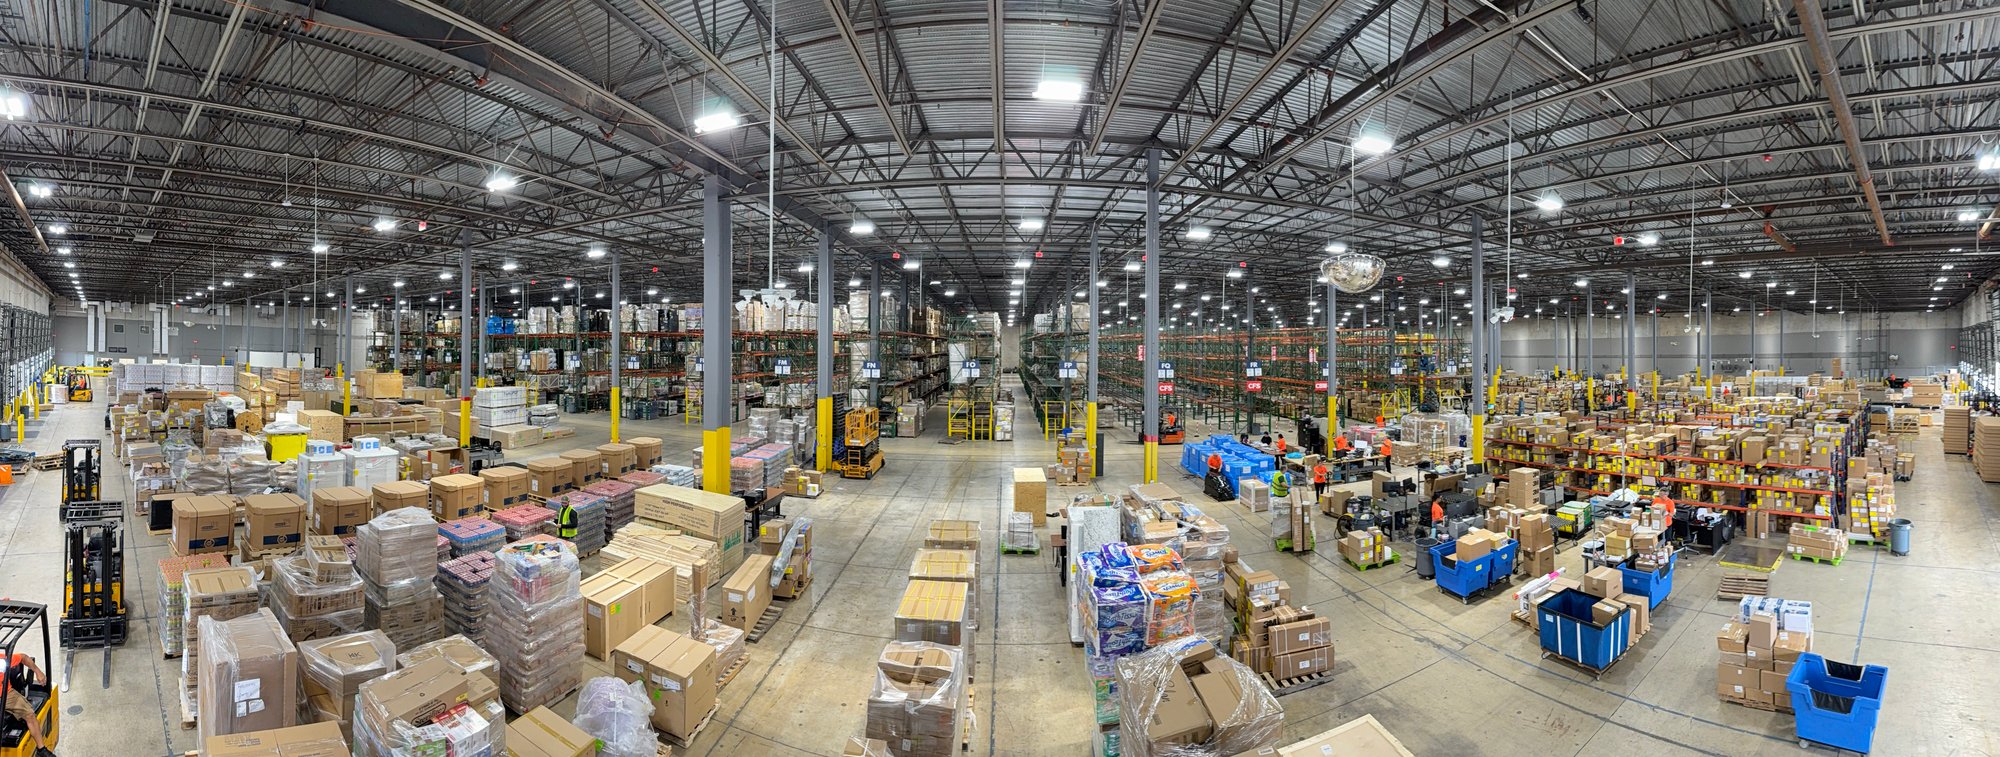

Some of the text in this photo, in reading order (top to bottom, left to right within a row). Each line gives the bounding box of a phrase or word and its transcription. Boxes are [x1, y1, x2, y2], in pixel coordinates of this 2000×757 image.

[361, 441, 379, 449] ICE
[1263, 605, 1273, 613] 3M
[1264, 617, 1278, 628] 3M
